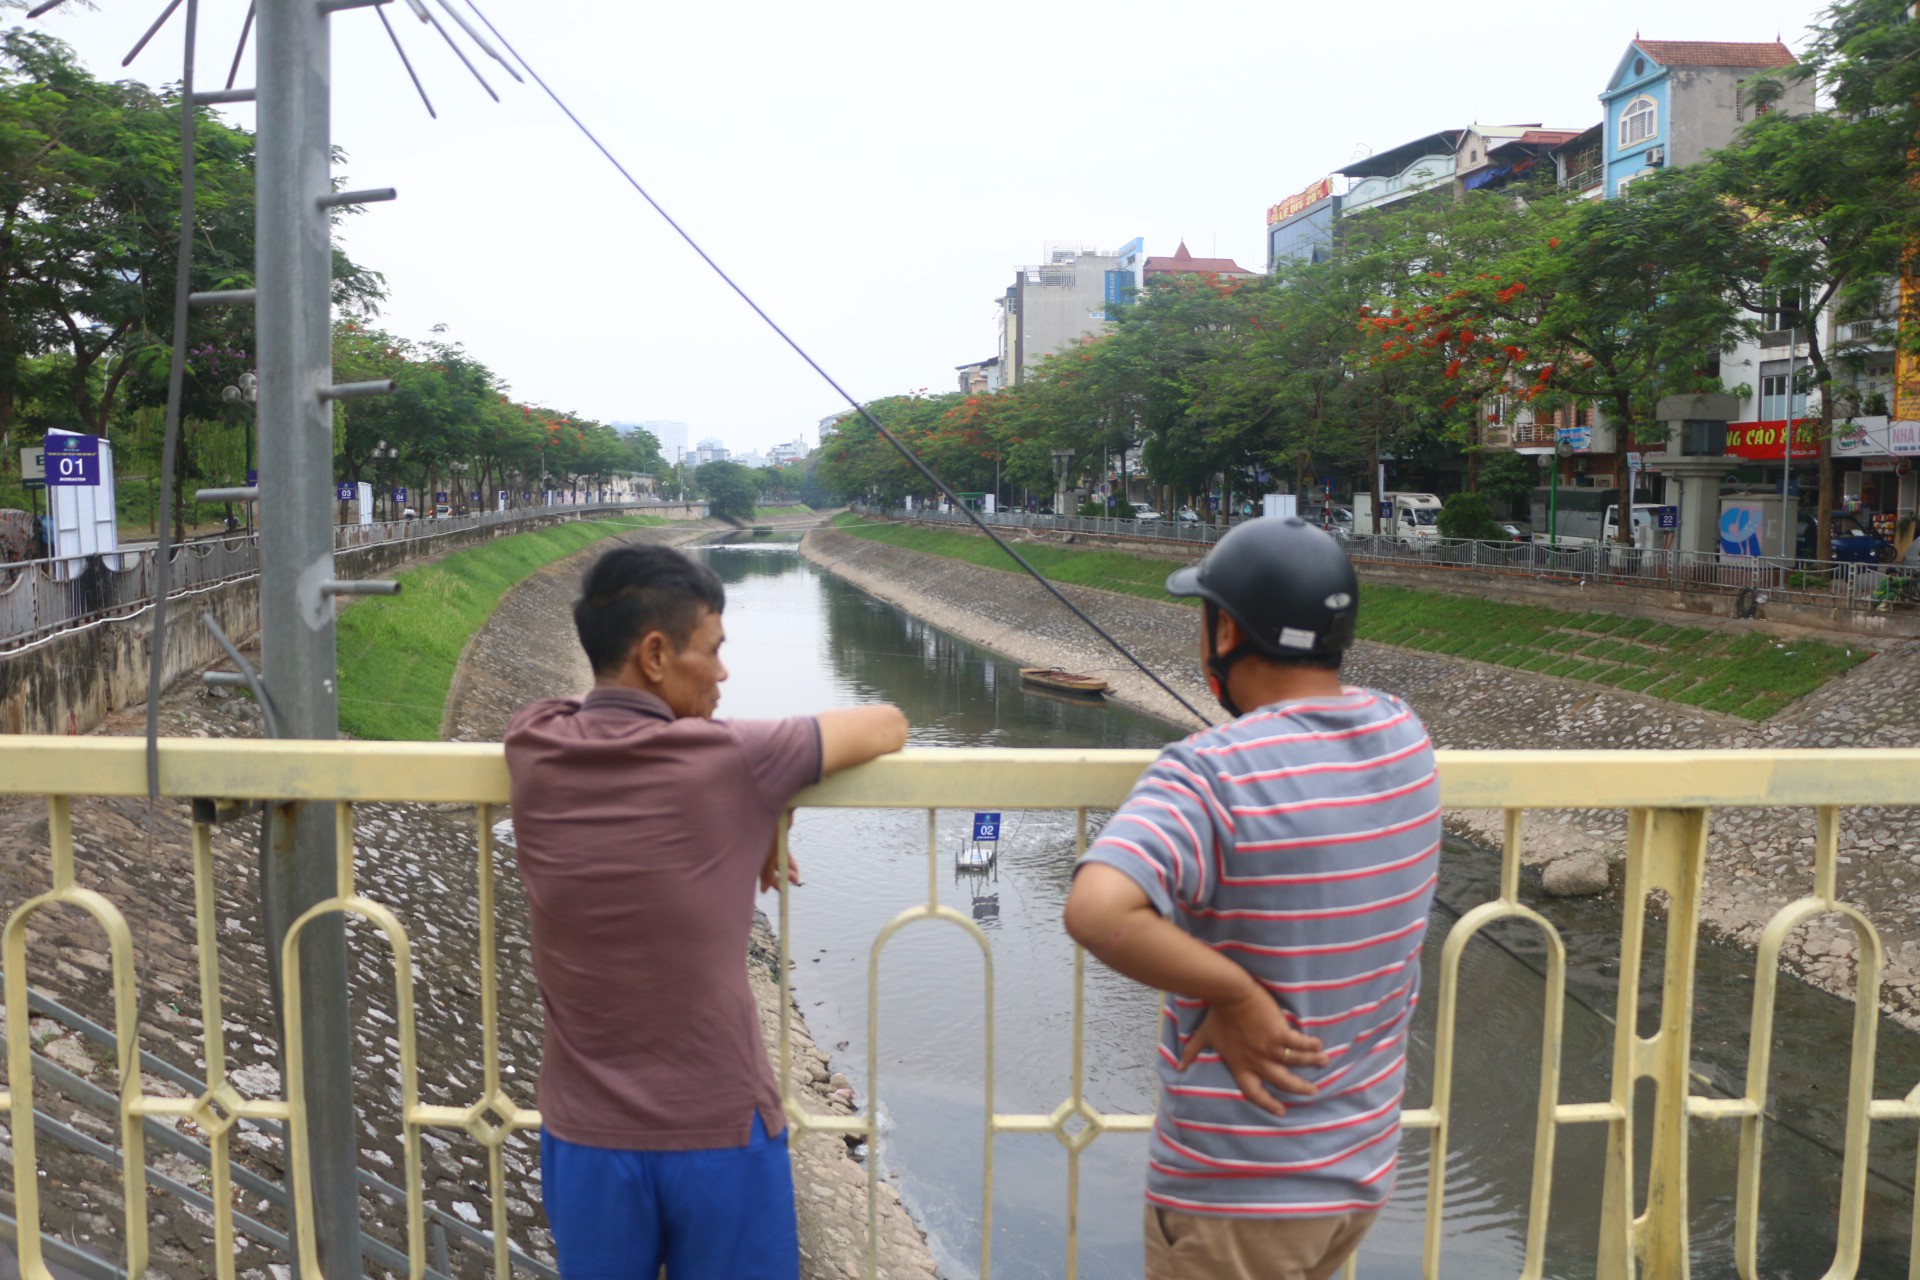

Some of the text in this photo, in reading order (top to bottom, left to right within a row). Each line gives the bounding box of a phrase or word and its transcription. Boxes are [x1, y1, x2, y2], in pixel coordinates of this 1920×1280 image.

[1746, 426, 1776, 445] CÁO
[60, 457, 83, 475] 01
[341, 489, 351, 497] 03
[1663, 515, 1673, 524] 22
[981, 825, 994, 835] 02
